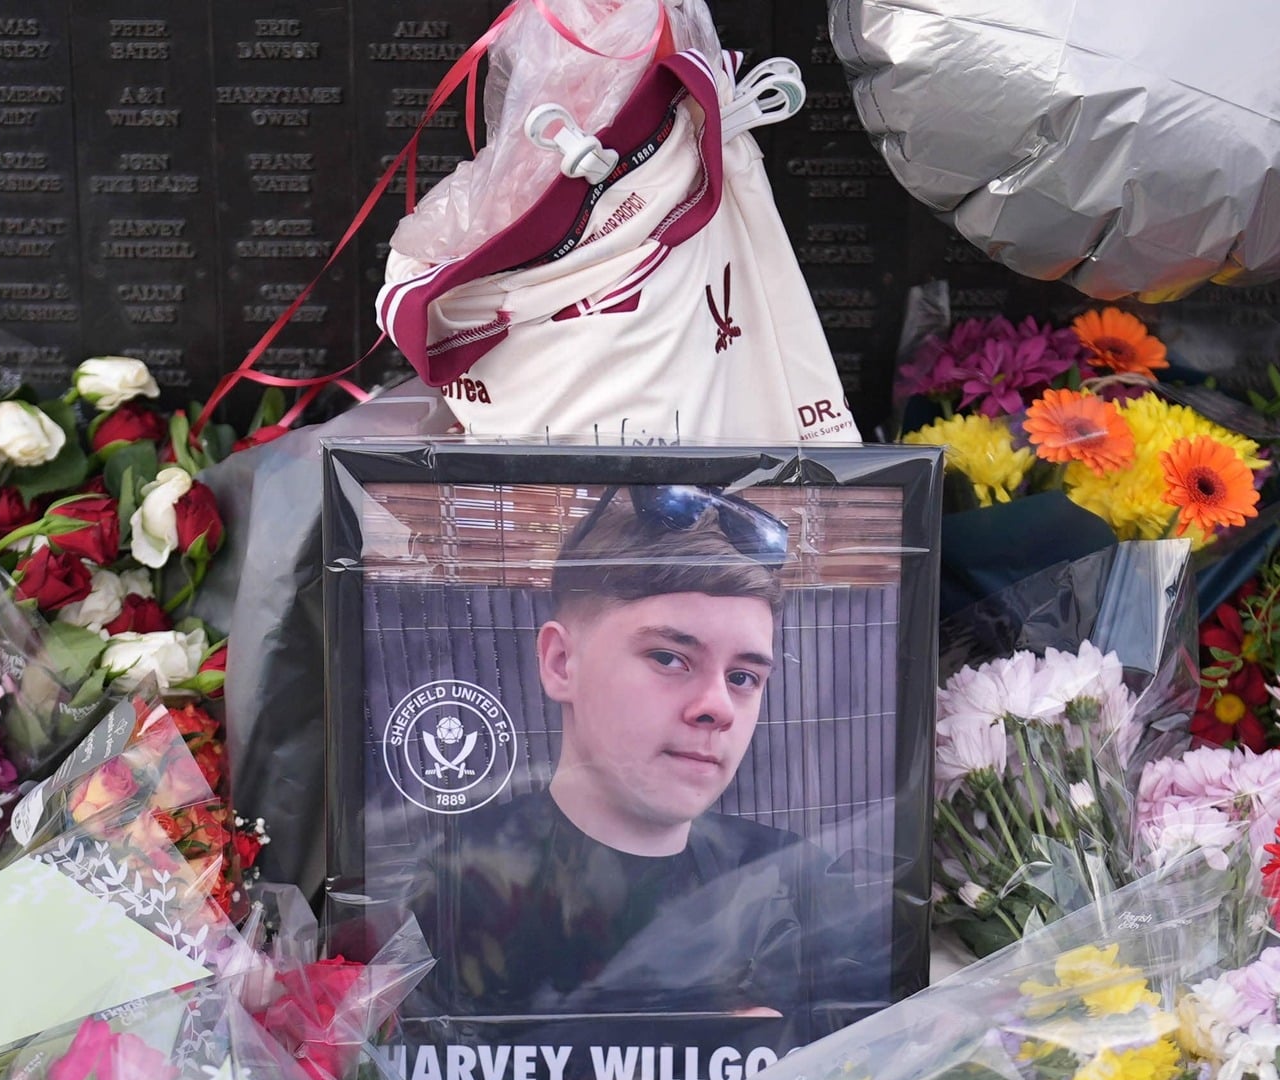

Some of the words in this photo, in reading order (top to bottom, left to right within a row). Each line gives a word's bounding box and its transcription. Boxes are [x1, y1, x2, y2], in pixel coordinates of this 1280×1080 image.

[110, 20, 169, 37] PETER
[255, 19, 302, 37] ERIC
[394, 21, 450, 39] ALAN
[110, 42, 170, 60] BATES
[237, 42, 320, 60] DAWSON
[106, 109, 180, 128] WILSON
[251, 109, 310, 127] OWEN
[120, 153, 169, 171] JOHN
[249, 153, 315, 171] FRANK
[136, 175, 200, 193] BLADE
[253, 175, 311, 193] YATES
[108, 219, 186, 237] HARVEY
[250, 219, 316, 237] ROGER
[100, 241, 196, 260] MITCHELL
[127, 305, 178, 323] WASS
[797, 399, 842, 428] DR.
[820, 420, 853, 436] Surgery
[390, 686, 448, 747] SHEFFIELD
[451, 685, 500, 721] UNITED
[494, 719, 511, 748] F.C.
[436, 794, 467, 806] 1889
